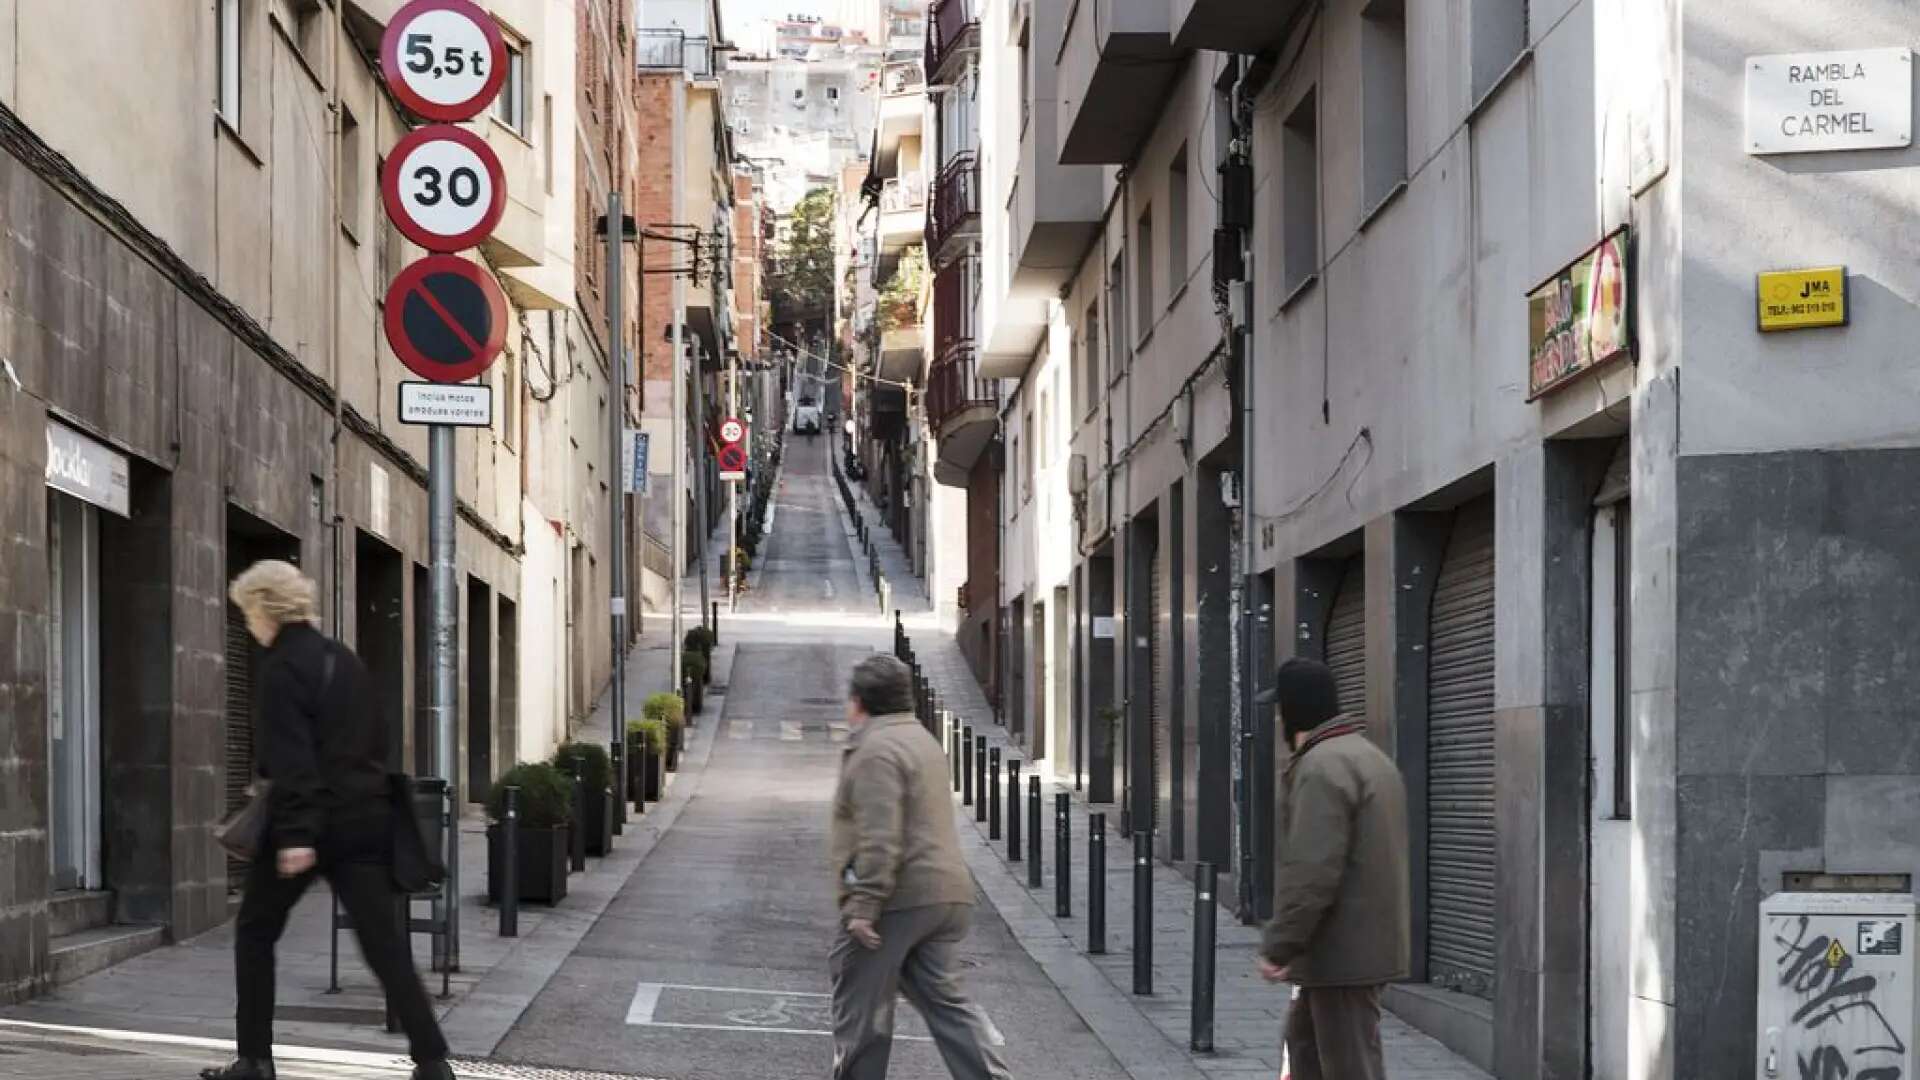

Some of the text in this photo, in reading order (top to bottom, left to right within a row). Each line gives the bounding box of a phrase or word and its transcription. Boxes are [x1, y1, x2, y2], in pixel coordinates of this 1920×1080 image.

[406, 33, 485, 79] 5,5 t
[1789, 62, 1866, 83] RAMBLA
[1810, 88, 1844, 107] DEL
[1781, 112, 1874, 136] CARMEL
[413, 165, 480, 207] 30
[1800, 280, 1830, 298] JMA
